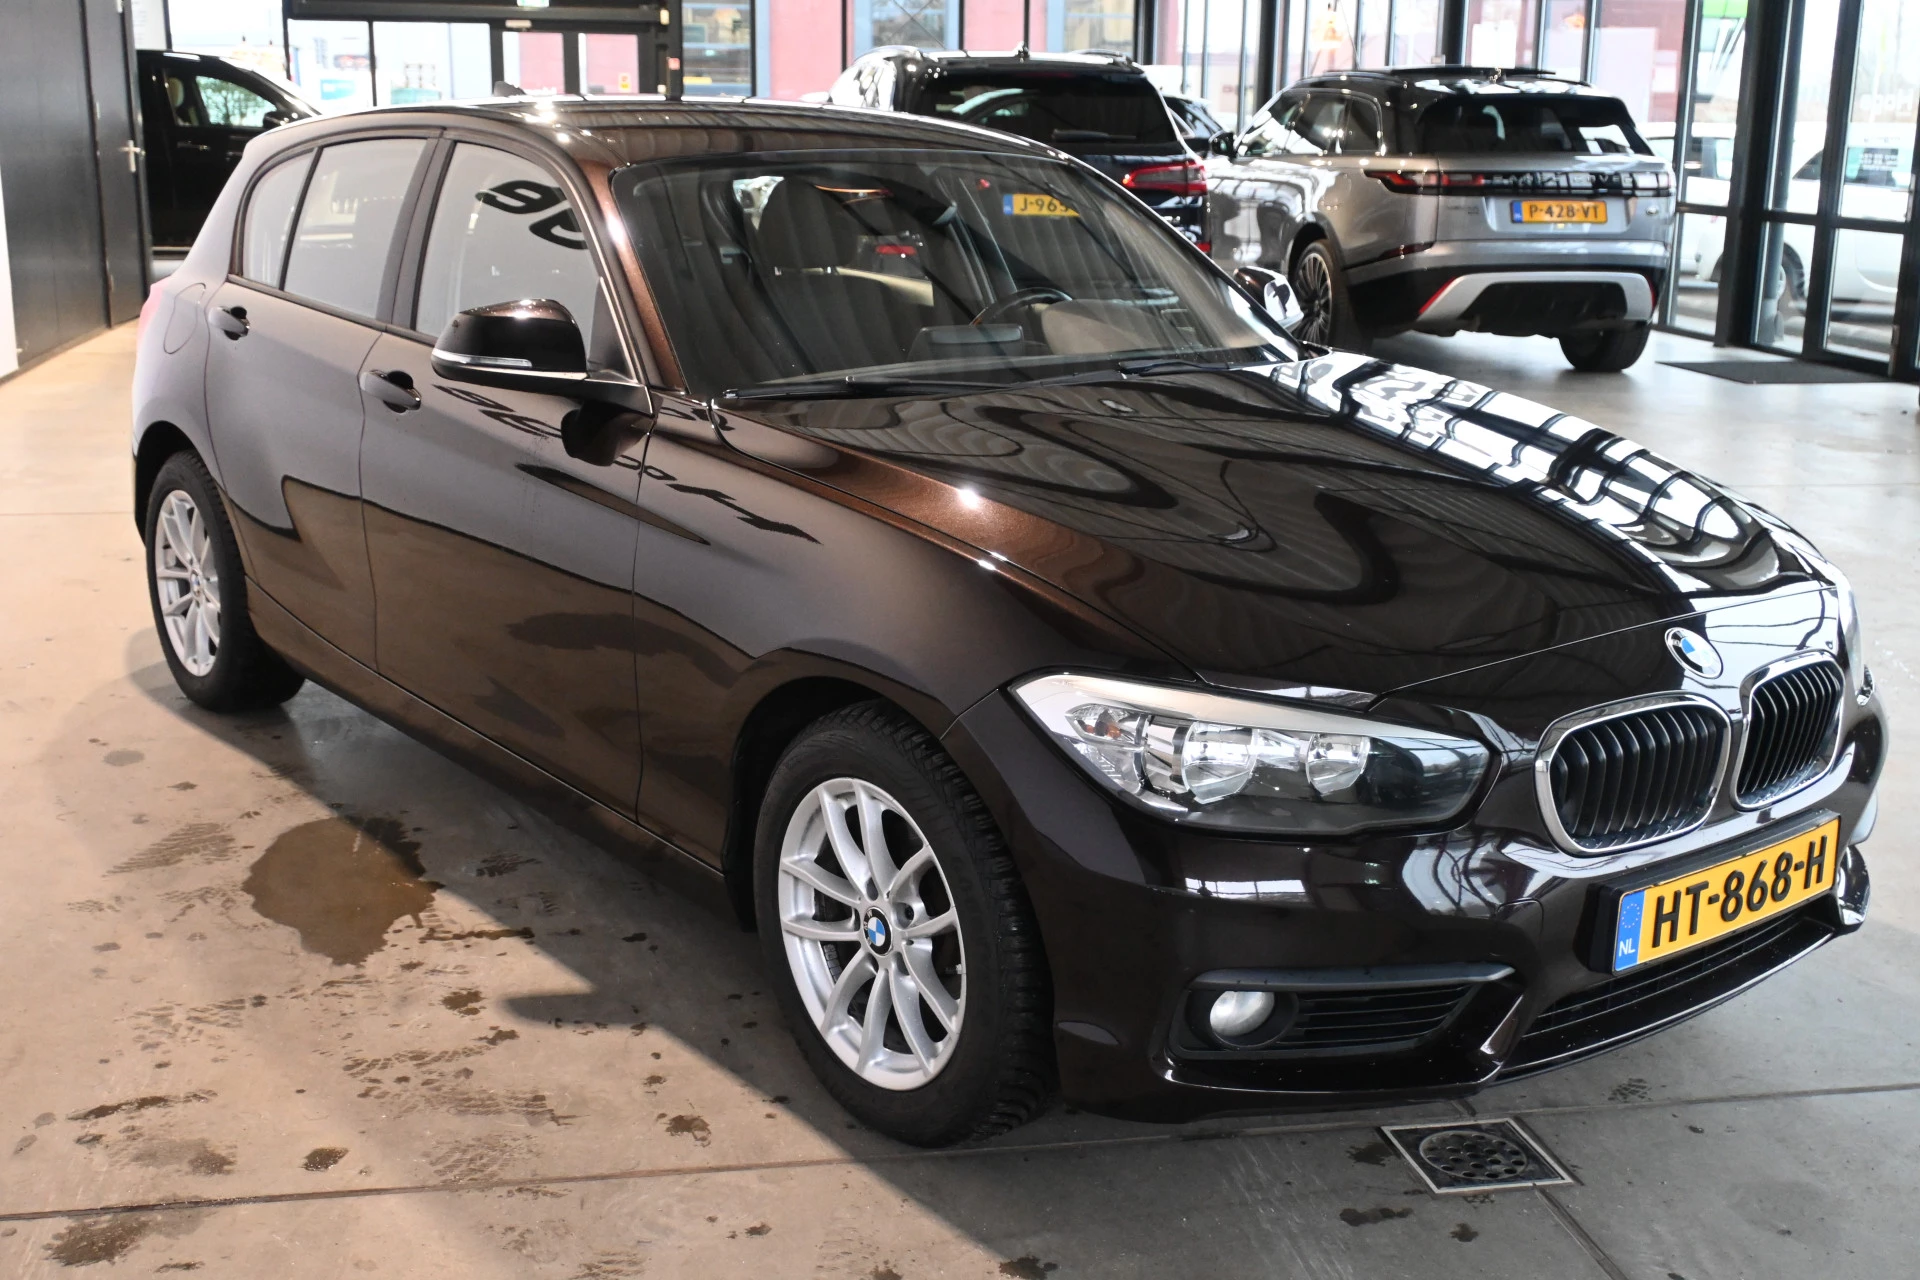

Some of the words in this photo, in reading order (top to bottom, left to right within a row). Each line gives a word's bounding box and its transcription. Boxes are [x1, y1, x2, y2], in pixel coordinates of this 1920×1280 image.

[1529, 204, 1599, 219] P-428-VT
[1652, 835, 1828, 949] HT-868-H
[1618, 937, 1636, 957] NL
